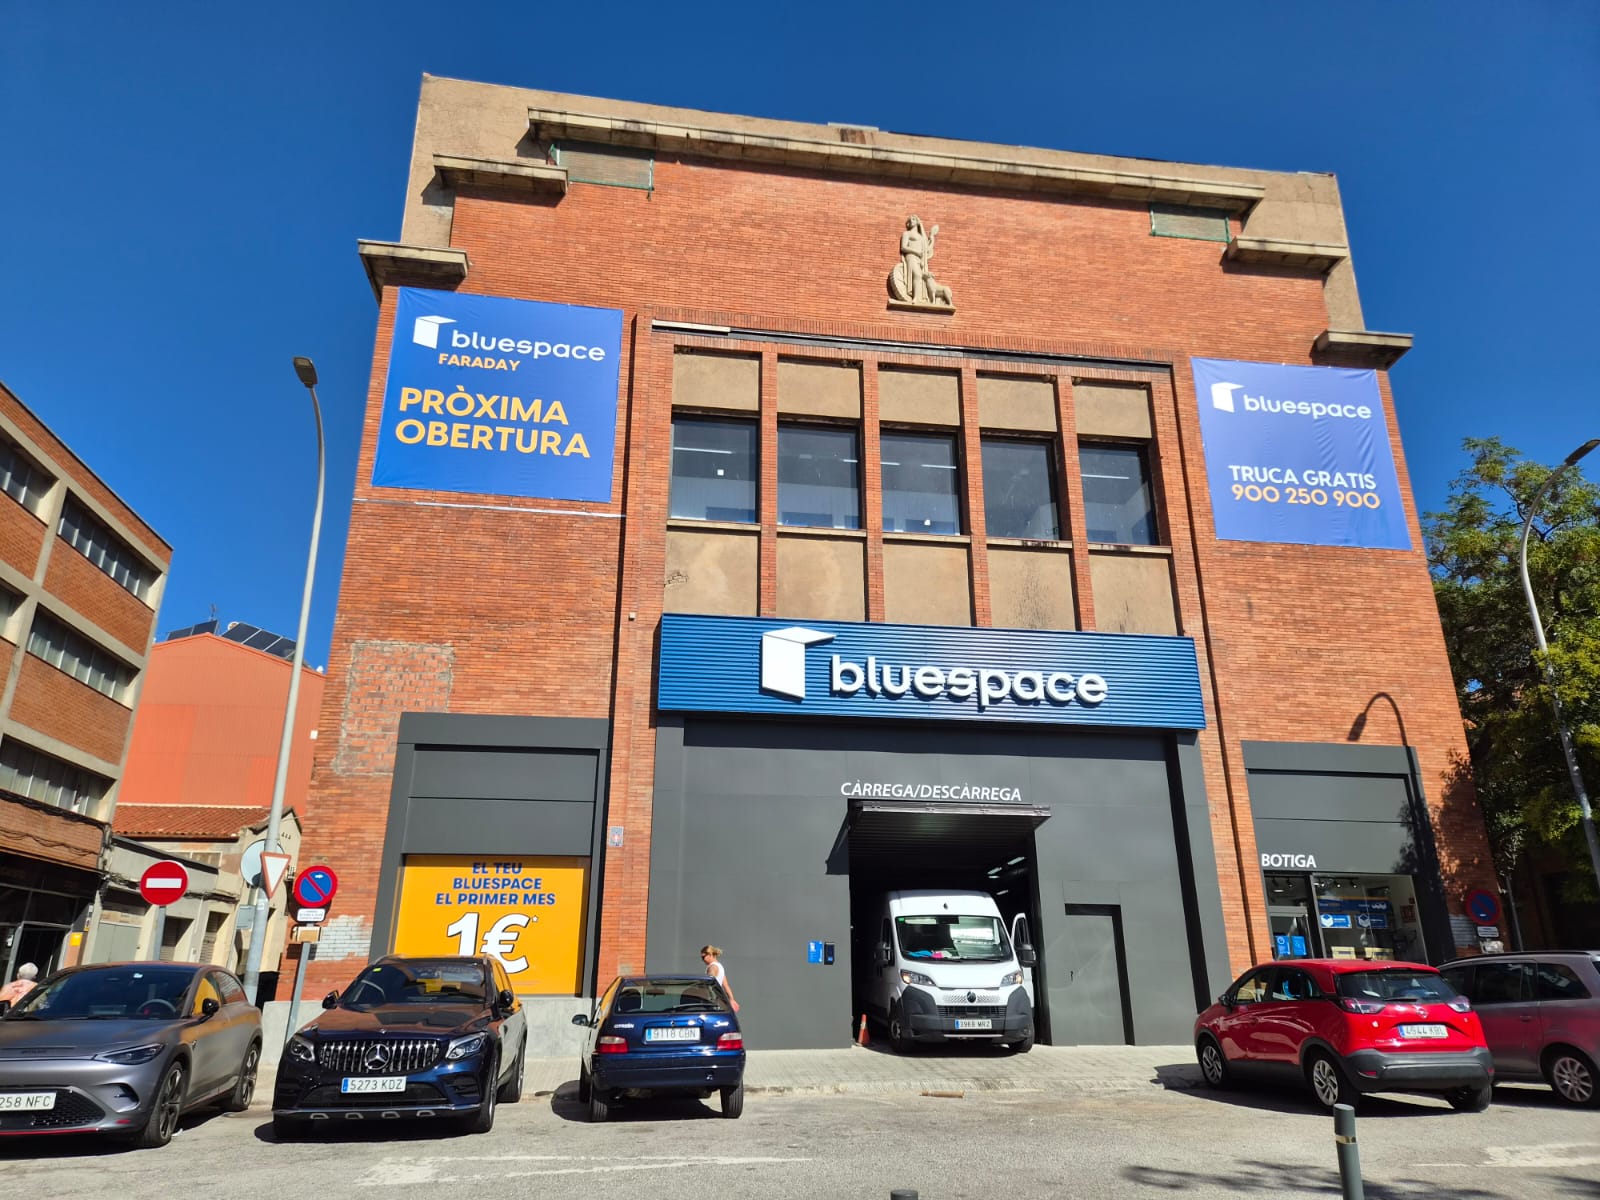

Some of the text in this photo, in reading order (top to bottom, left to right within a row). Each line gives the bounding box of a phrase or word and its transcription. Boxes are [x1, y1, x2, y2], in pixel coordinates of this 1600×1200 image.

[451, 329, 606, 362] bluespace
[438, 353, 521, 372] FARADAY
[399, 384, 569, 426] PRÒXIMA
[1243, 394, 1372, 420] bluespace
[395, 418, 591, 459] OBERTURA
[1228, 465, 1377, 490] TRUCA GRATIS
[1232, 484, 1381, 509] 900 250 900
[831, 655, 1108, 708] bluespace
[840, 779, 1022, 802] CÀRREGA/DESCÀRREGA
[472, 862, 522, 874] EL TEU
[1261, 853, 1317, 869] BOTIGA
[453, 878, 541, 889] BLUESPACE
[436, 893, 555, 905] EL PRIMER MES
[350, 1078, 403, 1091] 5273 KDZ
[25, 1095, 51, 1107] NFC
